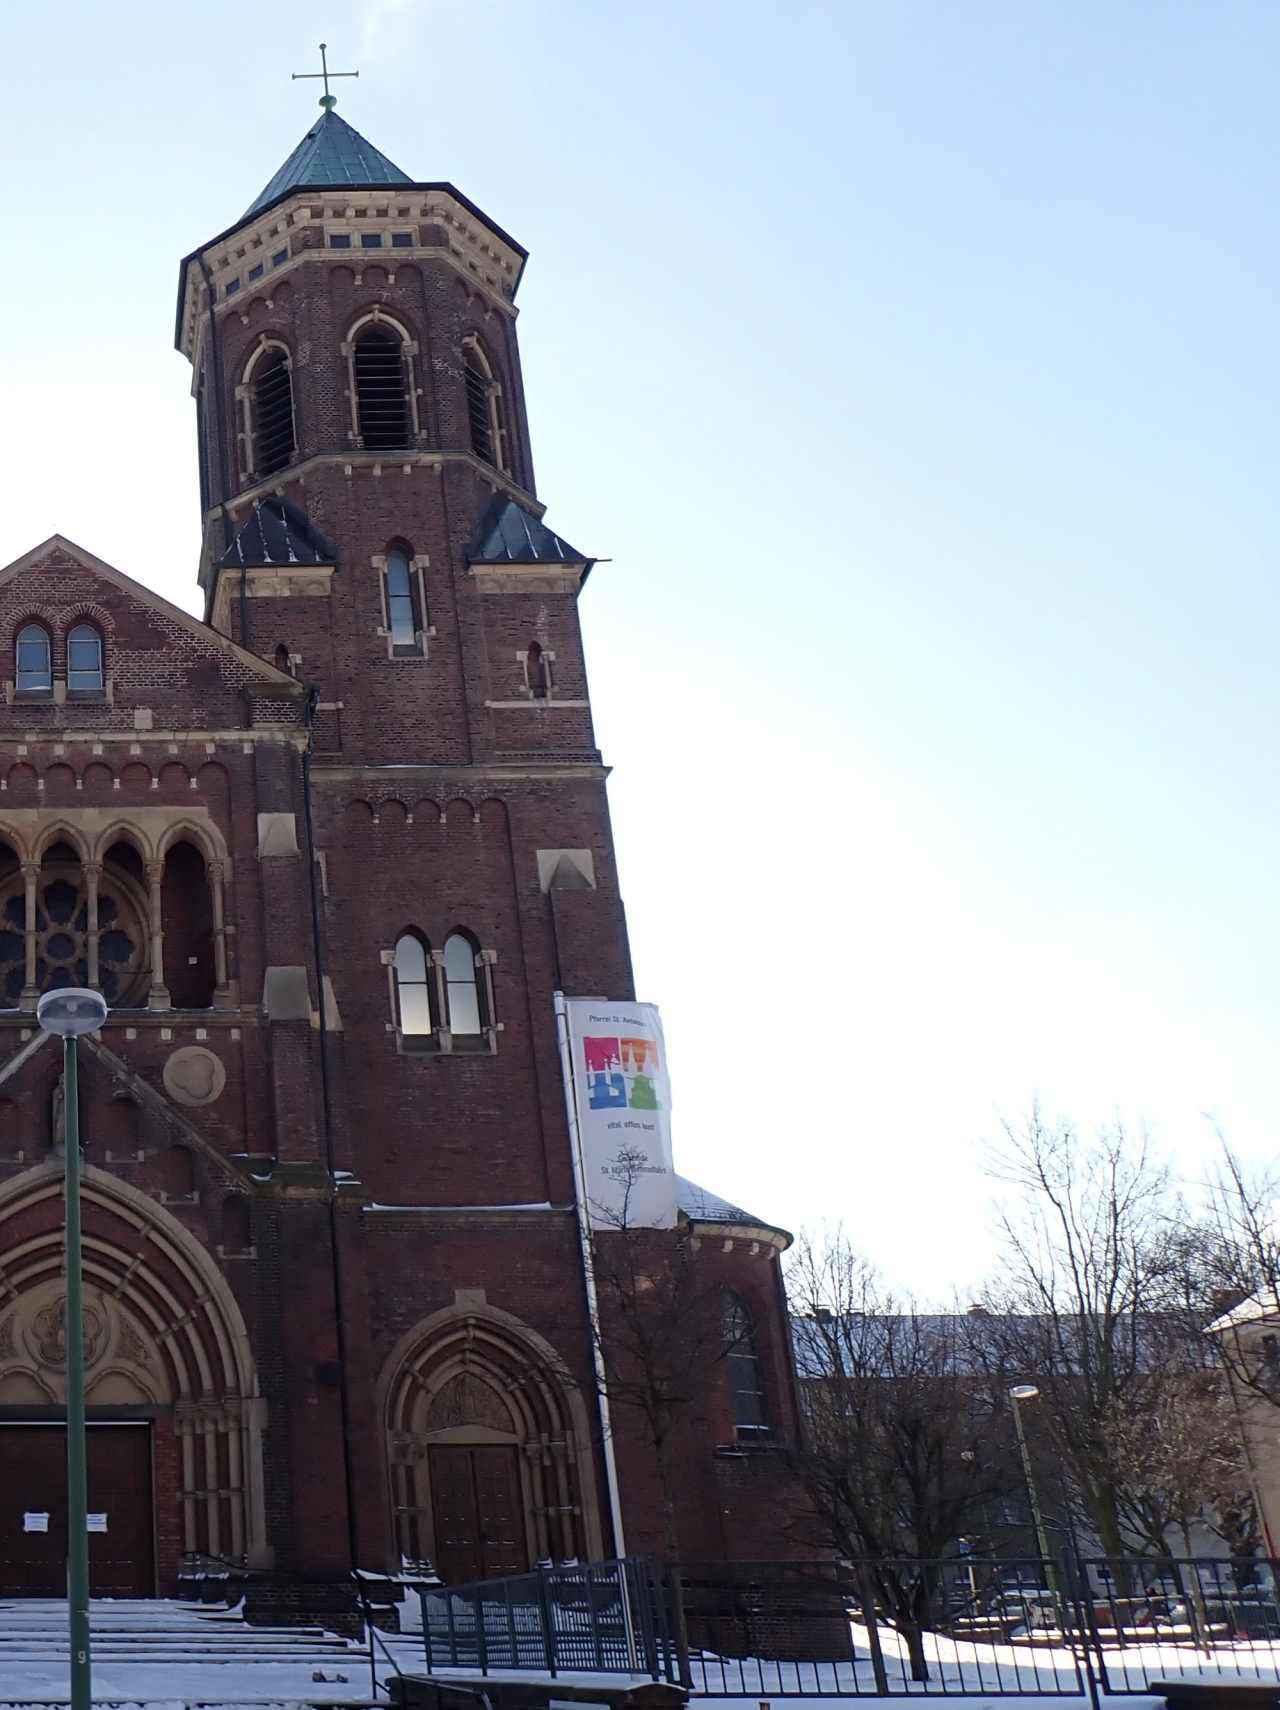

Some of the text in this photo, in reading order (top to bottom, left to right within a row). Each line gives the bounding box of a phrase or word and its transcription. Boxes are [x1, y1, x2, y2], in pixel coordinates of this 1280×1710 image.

[590, 1014, 610, 1022] Pfarrei
[606, 1122, 622, 1130] vital,
[624, 1120, 640, 1128] offen,
[600, 1166, 610, 1174] St.
[78, 1650, 86, 1664] 9
